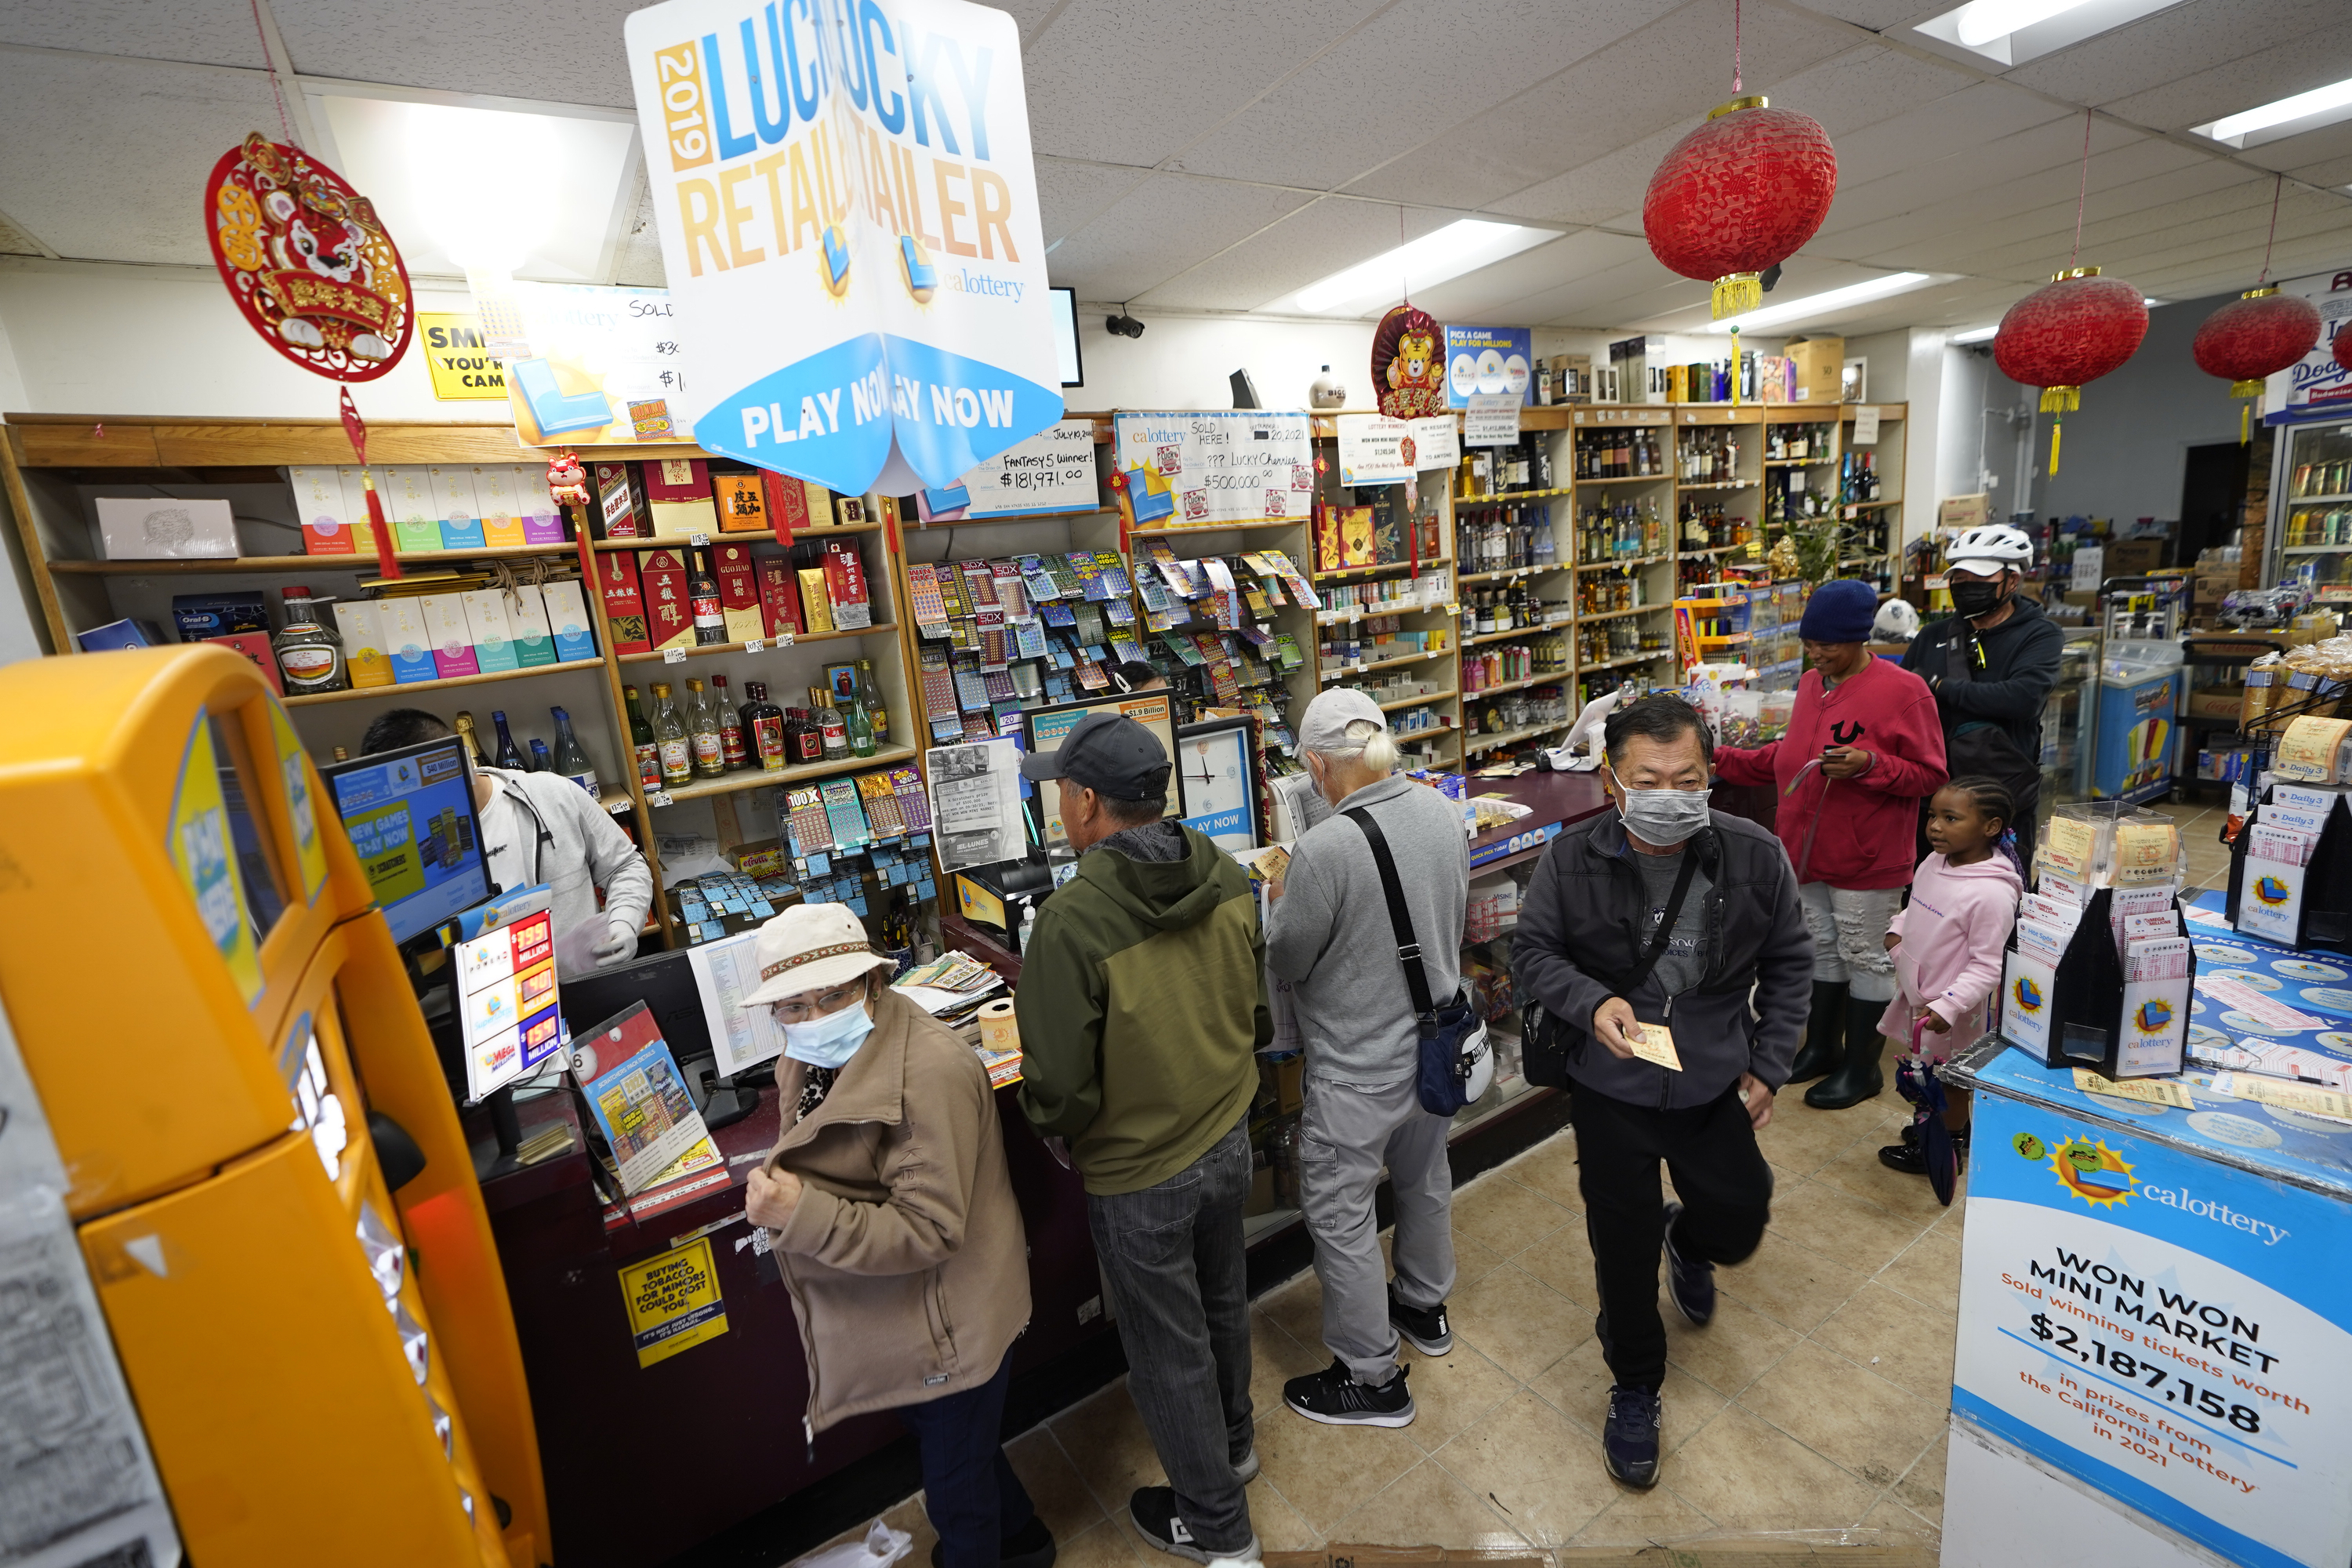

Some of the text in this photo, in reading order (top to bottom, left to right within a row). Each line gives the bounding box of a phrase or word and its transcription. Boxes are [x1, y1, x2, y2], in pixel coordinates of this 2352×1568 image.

[659, 48, 709, 162] 2019
[943, 268, 1025, 303] calottery
[930, 383, 1014, 428] NOW
[1383, 387, 1443, 418] 恭喜發財
[741, 388, 841, 448] PLAY
[1054, 429, 1073, 440] JULY
[1133, 427, 1186, 445] calottery
[1191, 422, 1216, 434] SOLD
[1004, 452, 1093, 470] FANTASY 5 Winner!
[1231, 452, 1258, 466] LUCKY
[1259, 452, 1298, 465] Cherries
[1204, 475, 1259, 489] $500,000
[720, 564, 750, 573] GUOJIAO
[1233, 558, 1243, 570] 11
[732, 578, 745, 597] 國窖
[1153, 643, 1164, 655] 22
[1177, 678, 1187, 691] 37
[1144, 706, 1164, 714] Billion
[1276, 704, 1285, 716] 52
[426, 759, 457, 774] $40 Million
[2289, 764, 2314, 775] Daily
[822, 781, 851, 790] $5,000,000
[789, 789, 820, 807] 100X
[2290, 793, 2314, 804] Daily
[349, 809, 409, 842] NEW GAMES
[1214, 813, 1240, 830] NOW
[2281, 814, 2307, 825] Daily
[384, 827, 408, 848] NOW
[968, 839, 989, 848] LUNES
[743, 855, 768, 866] efrutti
[1471, 844, 1508, 861] QUICK PICK TODAY
[2053, 858, 2074, 867] MILLIONS
[2055, 885, 2074, 895] MILLIONS
[499, 900, 532, 918] calottery
[2038, 903, 2053, 912] MEGA
[2038, 907, 2059, 916] MILLIONS
[2247, 904, 2289, 922] calottery
[2027, 928, 2053, 942] Hot Spot
[519, 942, 549, 964] MILLION
[2189, 933, 2319, 960] MAKE YOUR
[1492, 979, 1511, 990] SUPERMAN
[524, 992, 553, 1012] MILLION
[2009, 1007, 2043, 1033] calottery
[528, 1036, 557, 1062] MILLION
[2128, 1038, 2174, 1051] calottery
[492, 1044, 515, 1065] MEGA
[626, 1058, 640, 1072] PACK
[638, 1049, 655, 1064] DETAILS
[2142, 1181, 2292, 1247] calottery
[646, 1258, 688, 1281] BUYING
[636, 1271, 705, 1305] FOR MINORS
[641, 1266, 695, 1292] TOBACCO
[639, 1280, 706, 1314] COULD COST
[2056, 1246, 2259, 1342] WON WON
[662, 1301, 690, 1314] YOU.
[2029, 1259, 2280, 1374] MINI MARKET
[643, 1307, 716, 1341] IT'S NOT JUST WRONG.
[659, 1318, 701, 1339] IT'S ILLEGAL.
[2001, 1272, 2312, 1415] Sold winning tickets worth
[2030, 1312, 2261, 1436] $2,187,158
[2059, 1372, 2212, 1456] in prizes from
[2019, 1370, 2256, 1494] the California Lottery
[2092, 1421, 2168, 1468] in 2021
